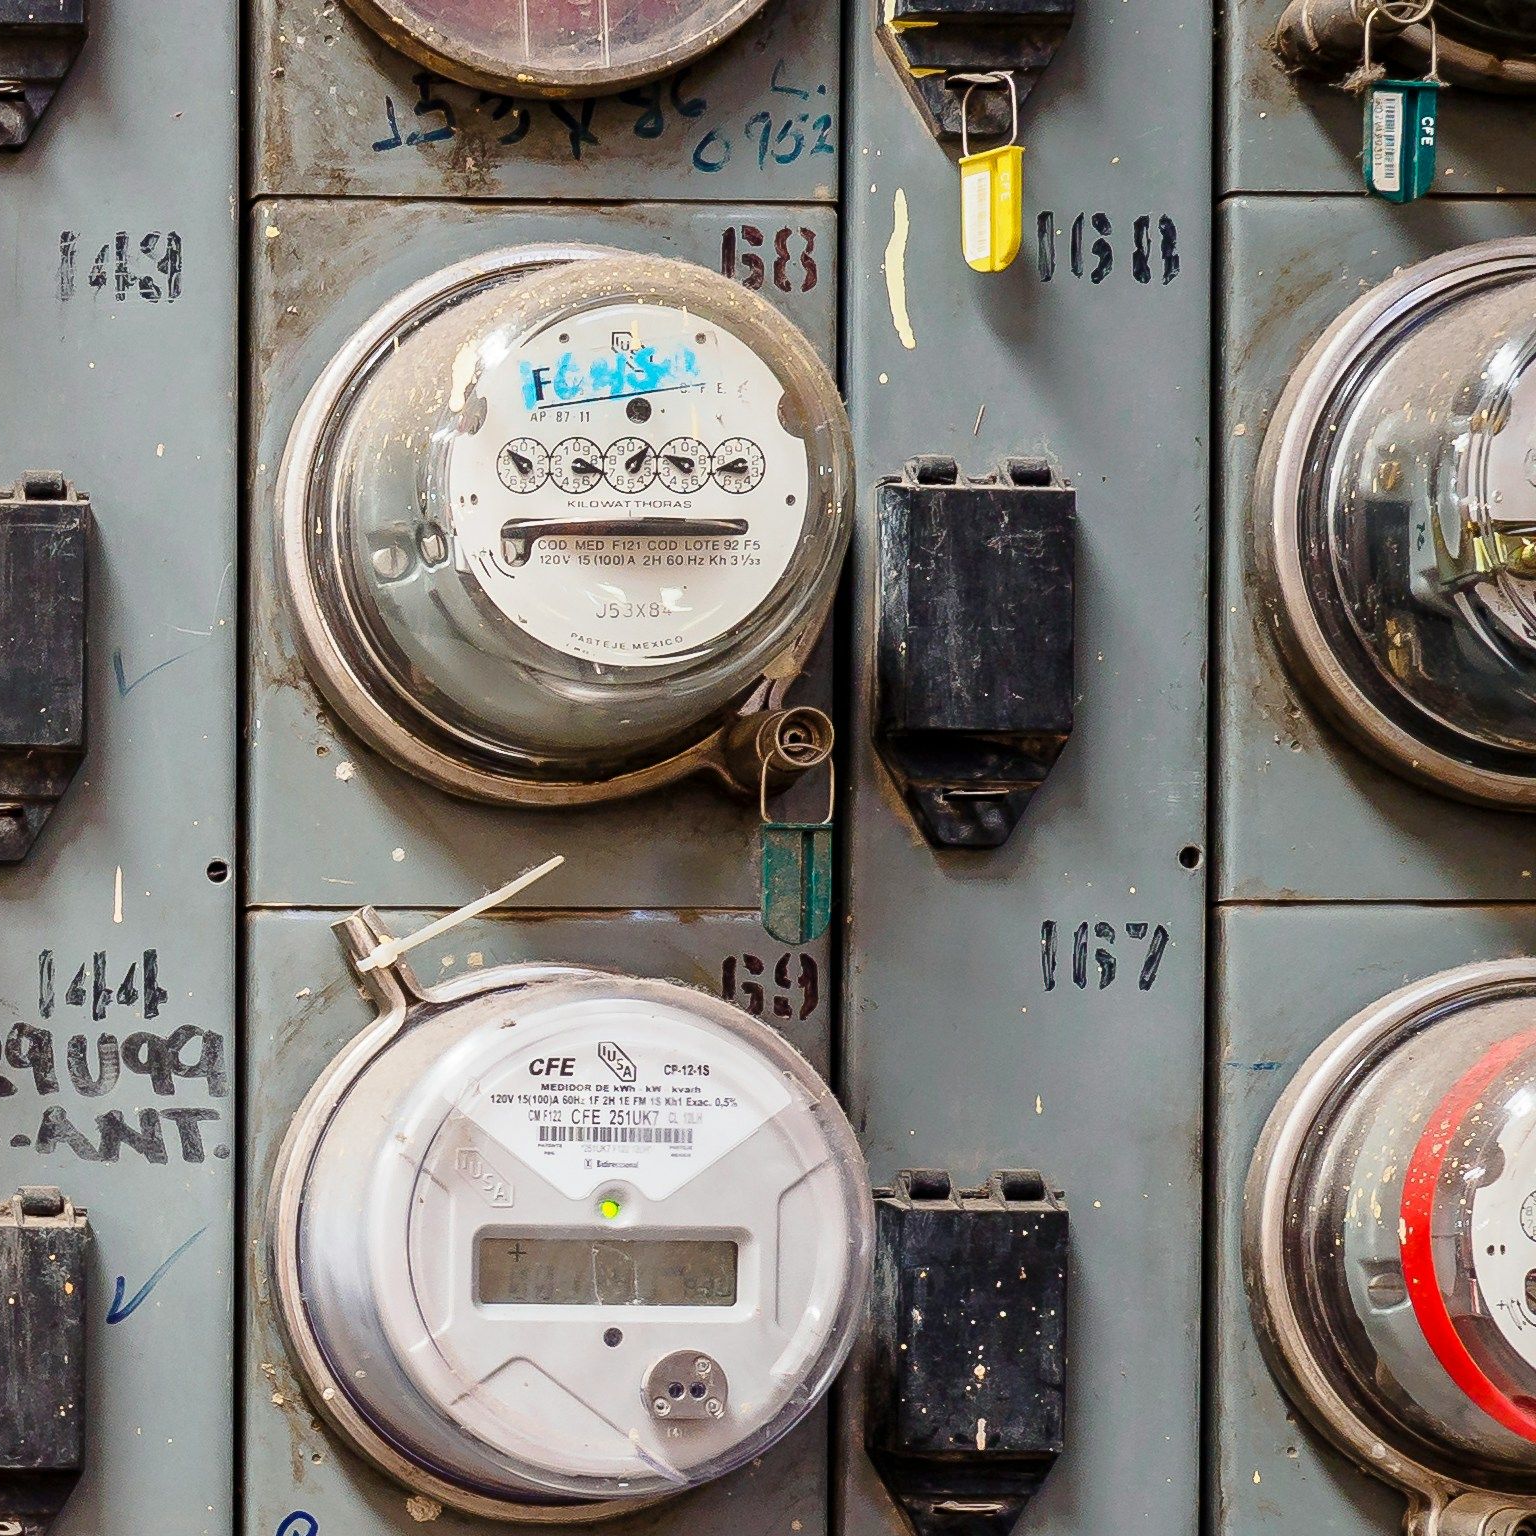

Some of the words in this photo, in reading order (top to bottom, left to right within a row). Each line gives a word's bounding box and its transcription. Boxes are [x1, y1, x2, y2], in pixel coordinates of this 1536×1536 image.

[1421, 117, 1435, 146] CFE
[720, 225, 817, 292] 68
[1036, 211, 1180, 287] 168
[575, 539, 604, 550] MED
[612, 540, 641, 550] F121
[647, 540, 678, 551] COD
[685, 540, 719, 550] LOTE
[1040, 920, 1170, 992] 167
[38, 949, 168, 1021] 144
[721, 953, 819, 1019] 69
[529, 1057, 575, 1077] CFE
[601, 1045, 633, 1078] IUSA
[540, 1083, 592, 1092] MEDIDOR
[595, 1083, 610, 1092] DE
[571, 1110, 601, 1125] CFE
